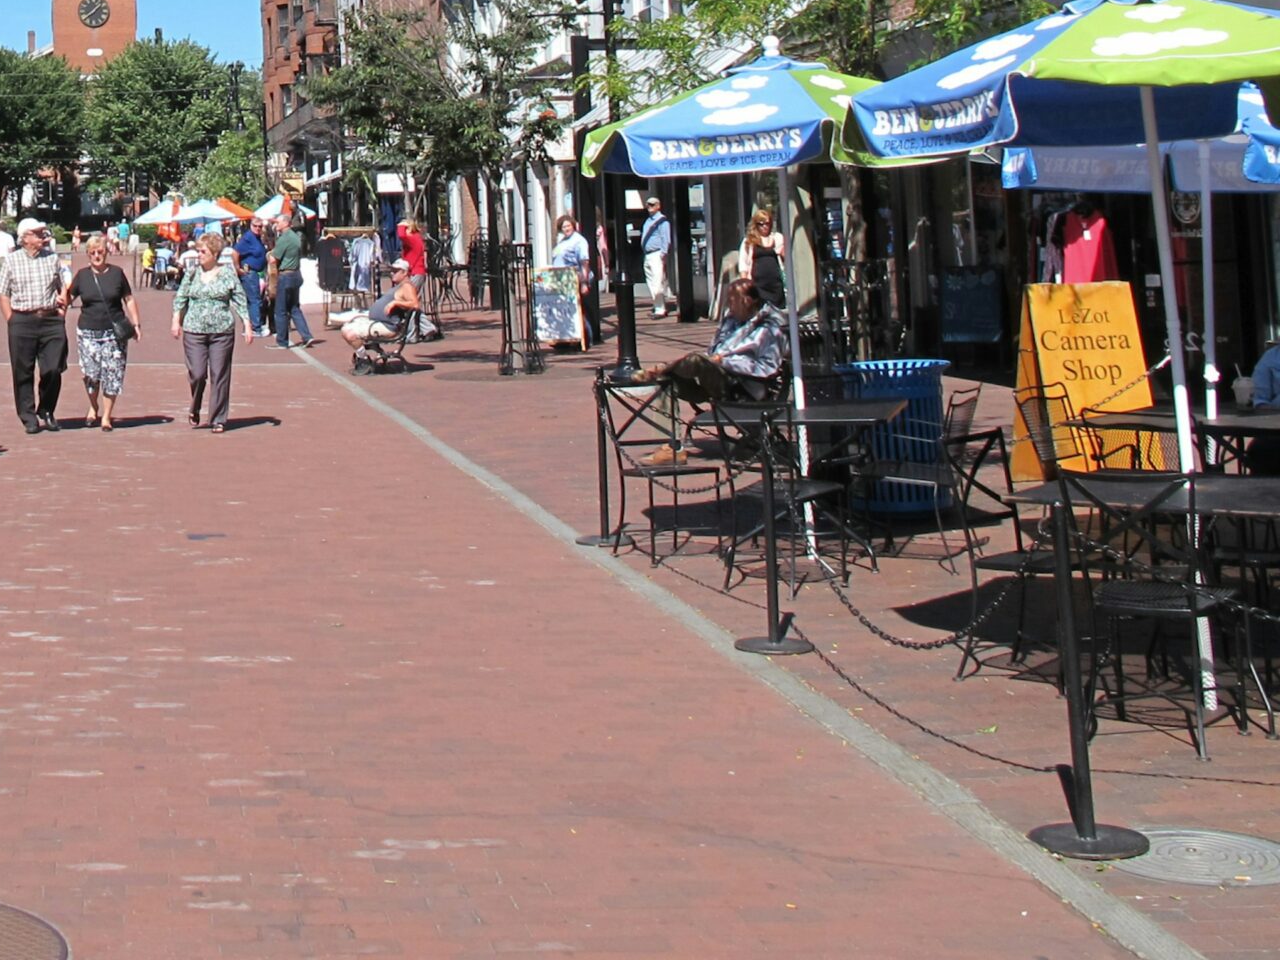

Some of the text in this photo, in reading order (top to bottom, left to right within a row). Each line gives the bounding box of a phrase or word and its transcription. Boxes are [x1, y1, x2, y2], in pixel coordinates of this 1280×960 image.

[883, 137, 920, 151] PEACE,
[663, 160, 697, 172] PEACE,
[701, 158, 726, 168] LOVE
[741, 155, 757, 166] ICE
[1057, 308, 1111, 325] LeZot
[1040, 329, 1132, 352] Camera
[1062, 358, 1122, 386] Shop
